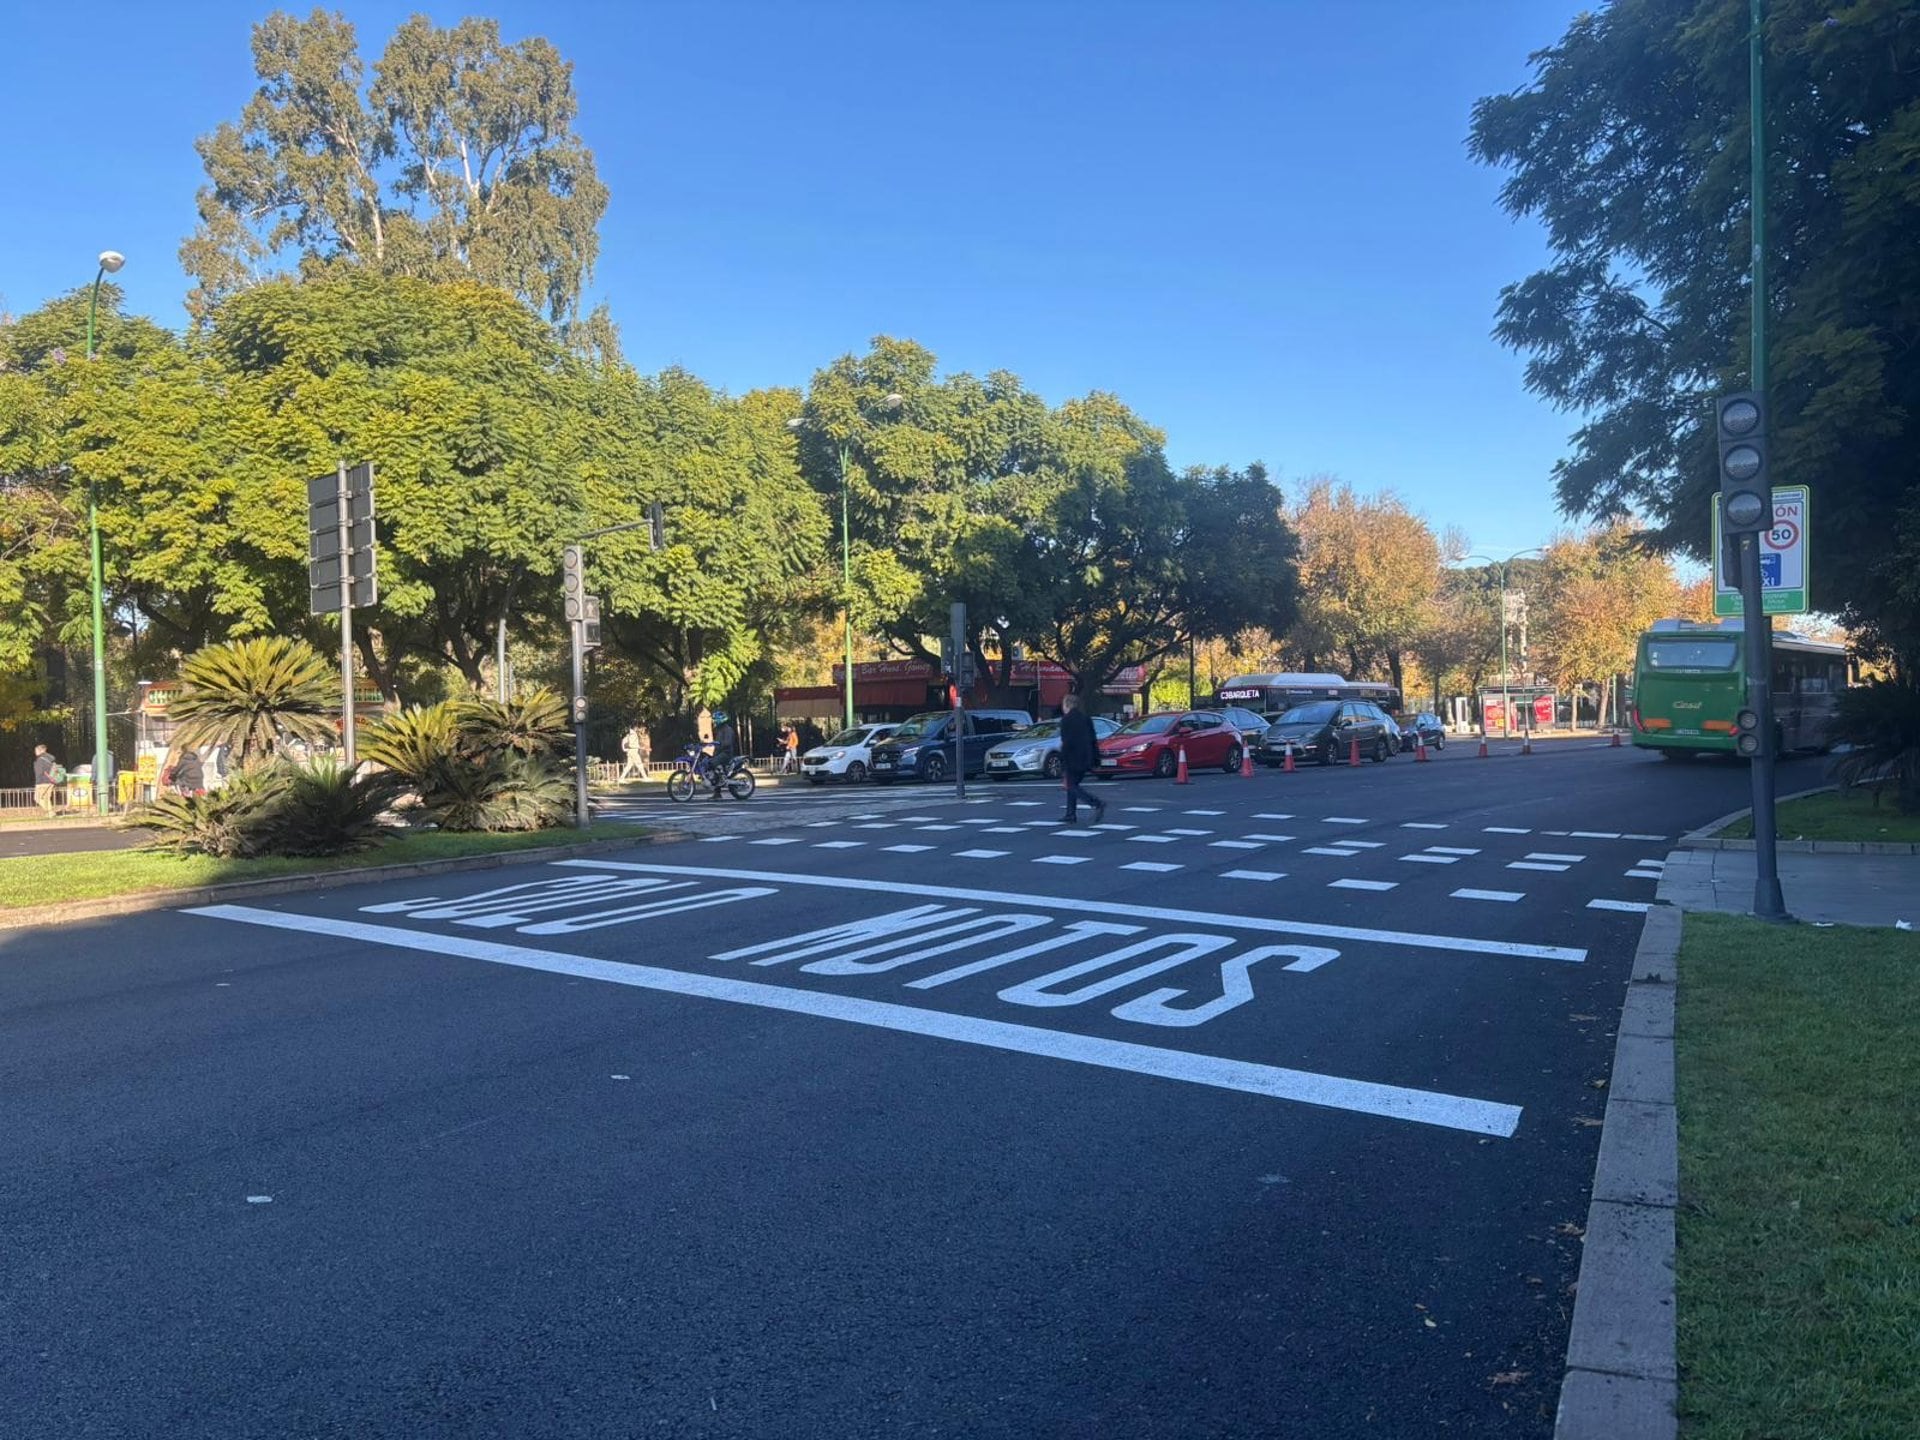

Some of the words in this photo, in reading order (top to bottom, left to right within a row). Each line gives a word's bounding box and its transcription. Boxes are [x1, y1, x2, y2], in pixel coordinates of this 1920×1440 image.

[1772, 529, 1791, 541] 50
[357, 874, 780, 936] SOLO
[707, 904, 1342, 1028] MOTOS
